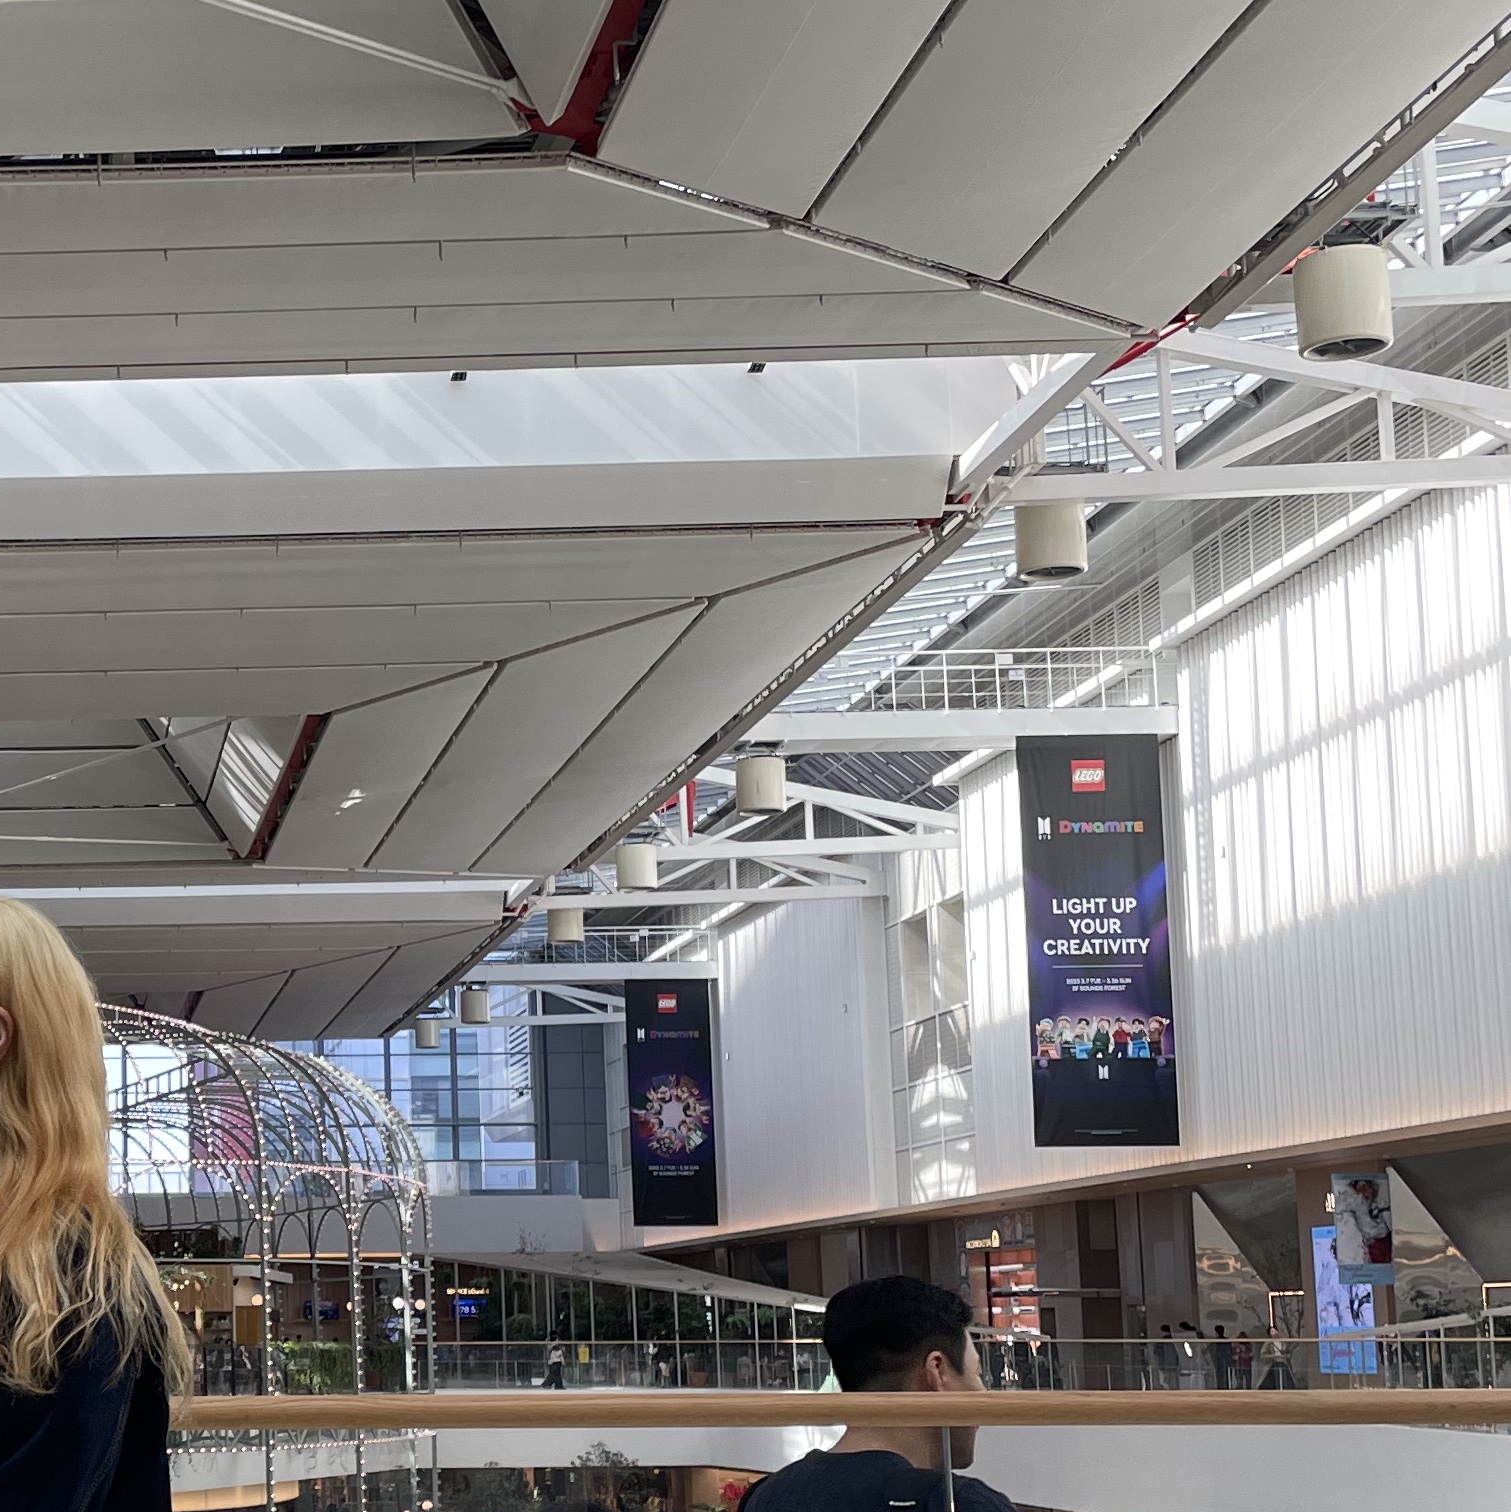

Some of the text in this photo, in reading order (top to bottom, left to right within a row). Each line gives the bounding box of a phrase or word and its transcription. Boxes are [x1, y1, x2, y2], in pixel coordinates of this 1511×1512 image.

[1073, 768, 1104, 783] LEGO
[1052, 897, 1137, 914] LIGHT UP
[1069, 918, 1122, 934] YOUR
[1043, 938, 1150, 955] CREATIVITY
